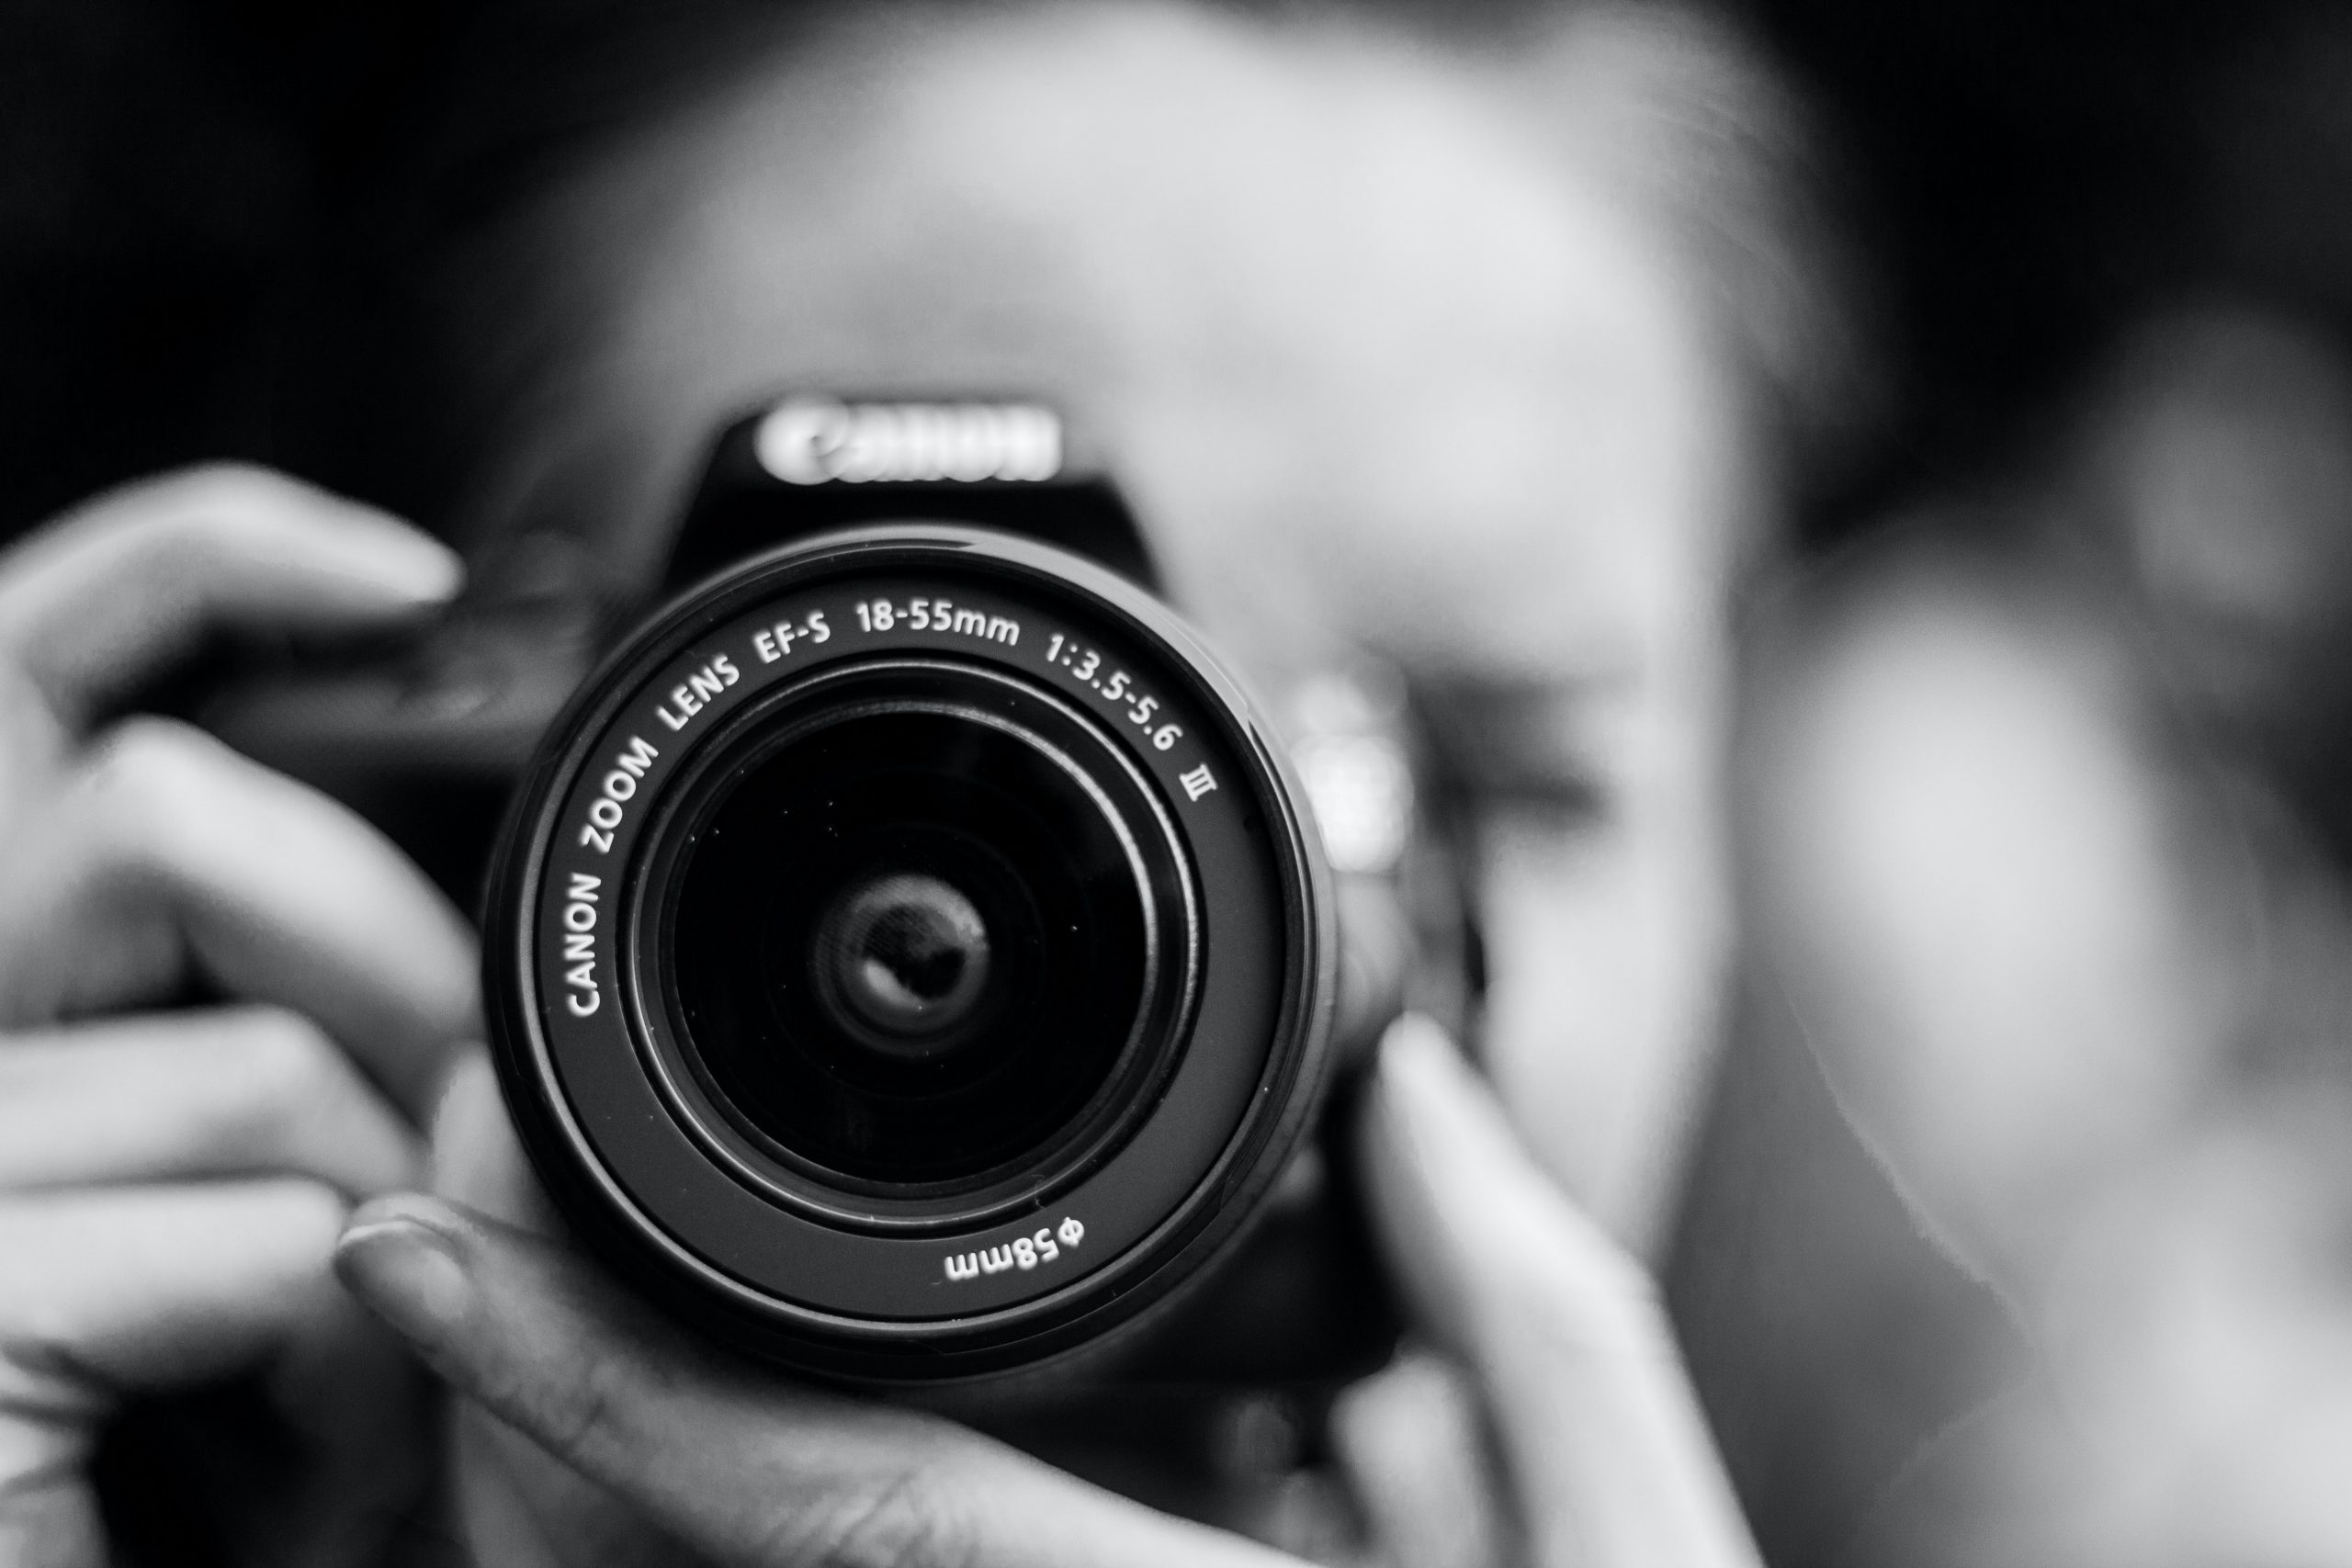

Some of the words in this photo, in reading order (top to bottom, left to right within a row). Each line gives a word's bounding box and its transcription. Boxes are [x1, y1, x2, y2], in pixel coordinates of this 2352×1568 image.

[753, 612, 831, 664] EF-S
[855, 599, 1020, 647] 18-55mm
[657, 655, 740, 731] LENS
[1046, 634, 1182, 750] 1:3.5-5.6
[580, 736, 659, 853] ZOOM
[564, 873, 602, 1017] CANON
